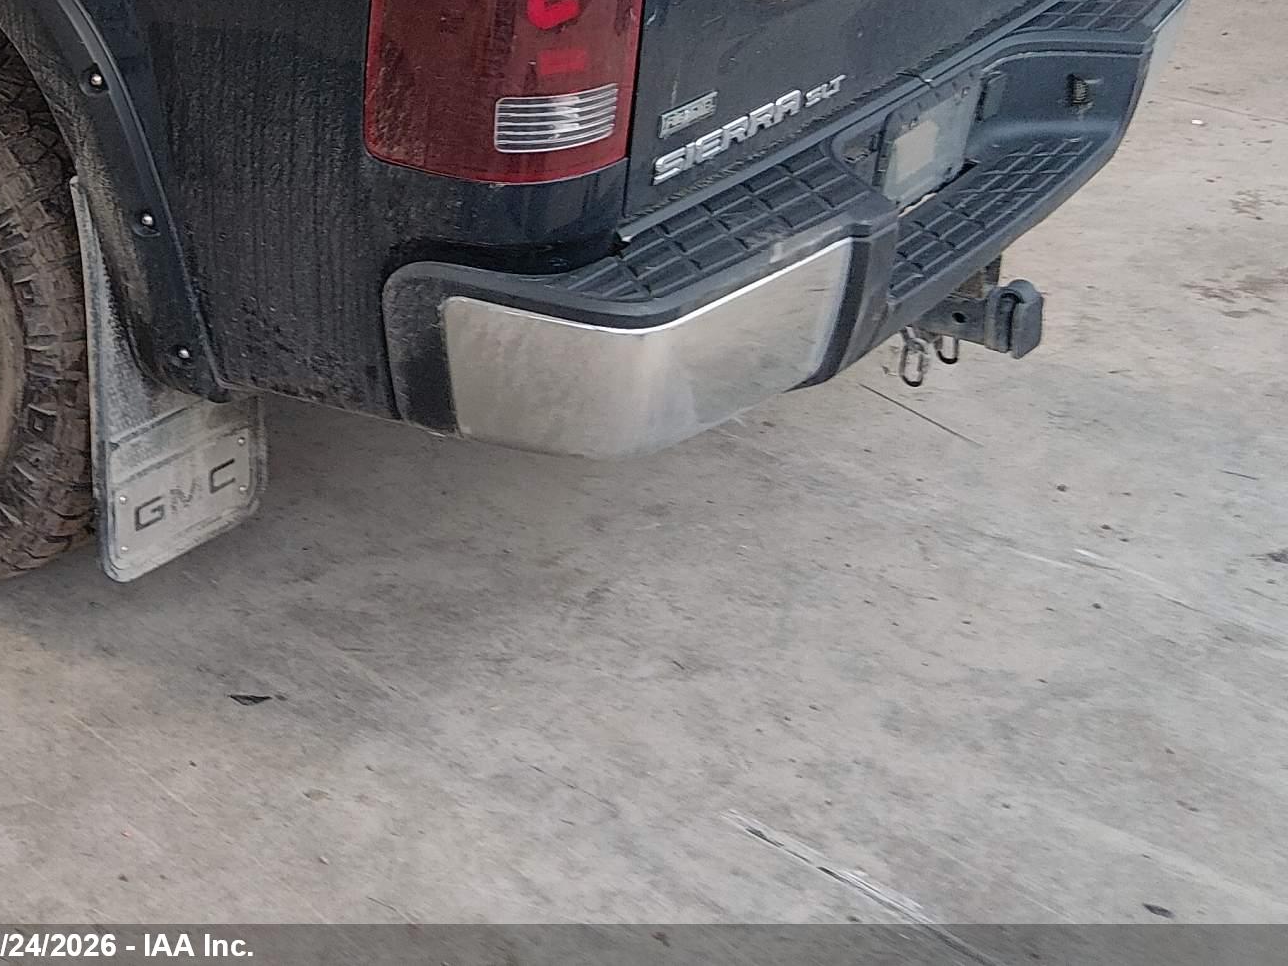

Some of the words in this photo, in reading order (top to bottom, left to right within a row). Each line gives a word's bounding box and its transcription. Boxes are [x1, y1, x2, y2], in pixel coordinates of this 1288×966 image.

[652, 89, 801, 186] SIERRA
[804, 74, 847, 108] SLT
[134, 457, 236, 532] GMC
